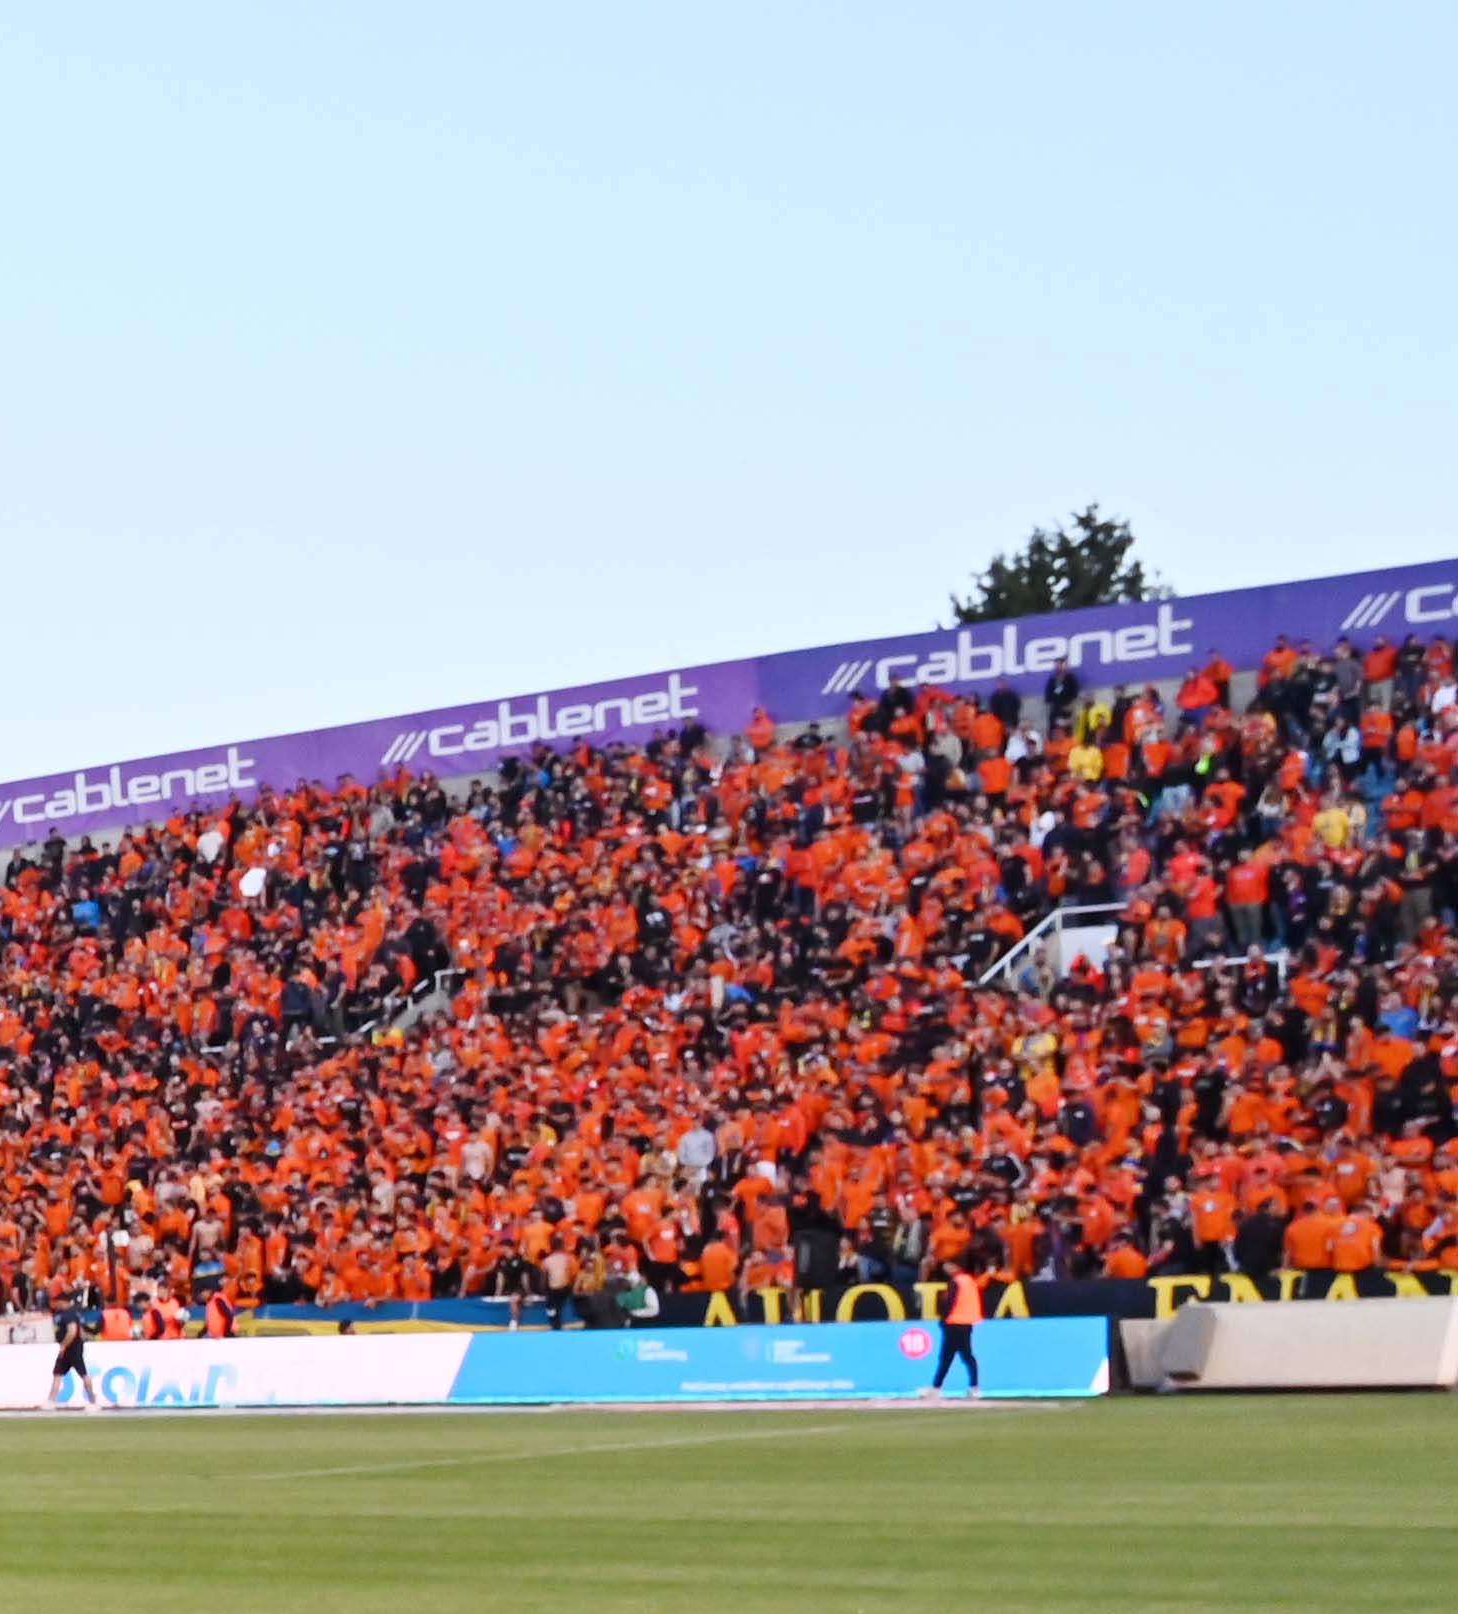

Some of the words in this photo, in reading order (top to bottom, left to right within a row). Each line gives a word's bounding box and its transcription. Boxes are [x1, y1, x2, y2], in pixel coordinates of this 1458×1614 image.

[1405, 584, 1458, 624] c
[875, 604, 1193, 688] cablenet
[428, 673, 699, 757] cablenet
[12, 747, 256, 825] cablenet
